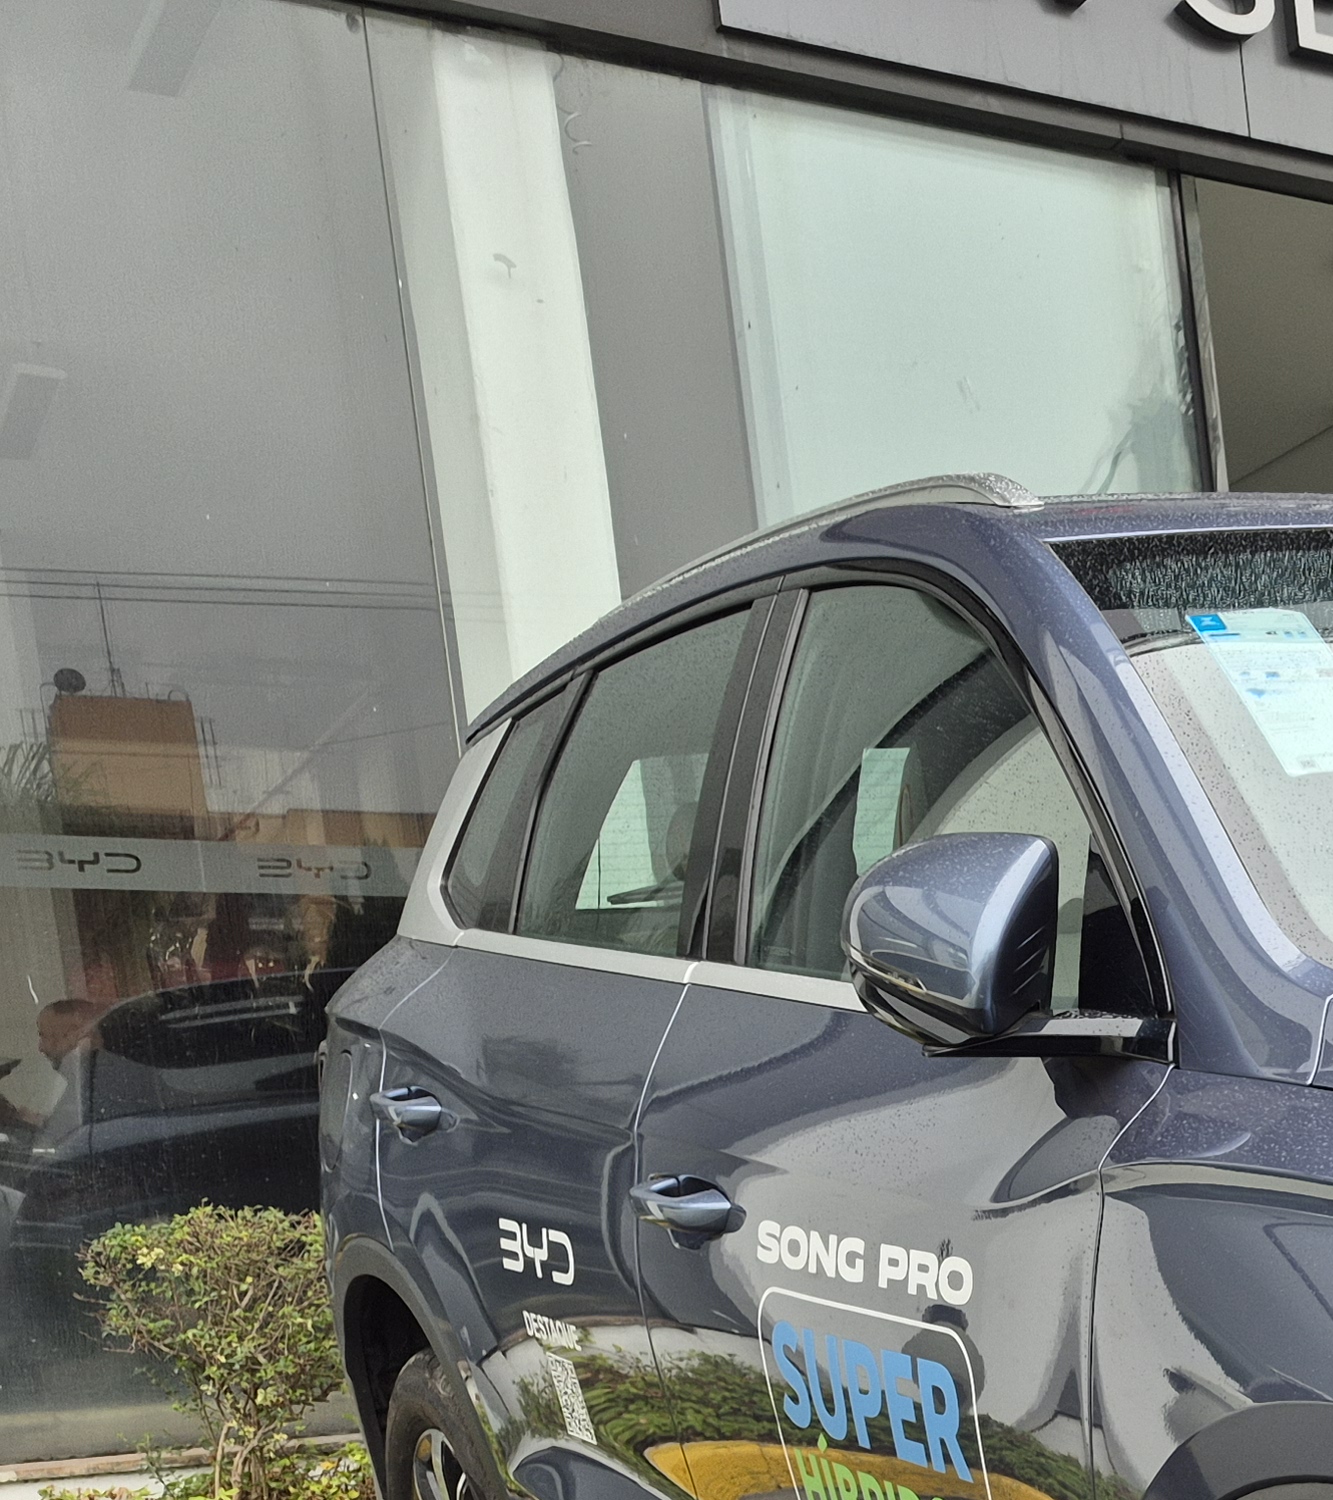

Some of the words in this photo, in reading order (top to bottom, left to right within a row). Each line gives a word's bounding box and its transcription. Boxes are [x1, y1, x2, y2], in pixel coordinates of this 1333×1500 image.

[499, 1217, 575, 1286] BYD
[757, 1220, 865, 1283] SONG
[878, 1243, 973, 1306] PRO
[522, 1310, 582, 1352] DESTAQUE
[772, 1320, 975, 1484] SUPER
